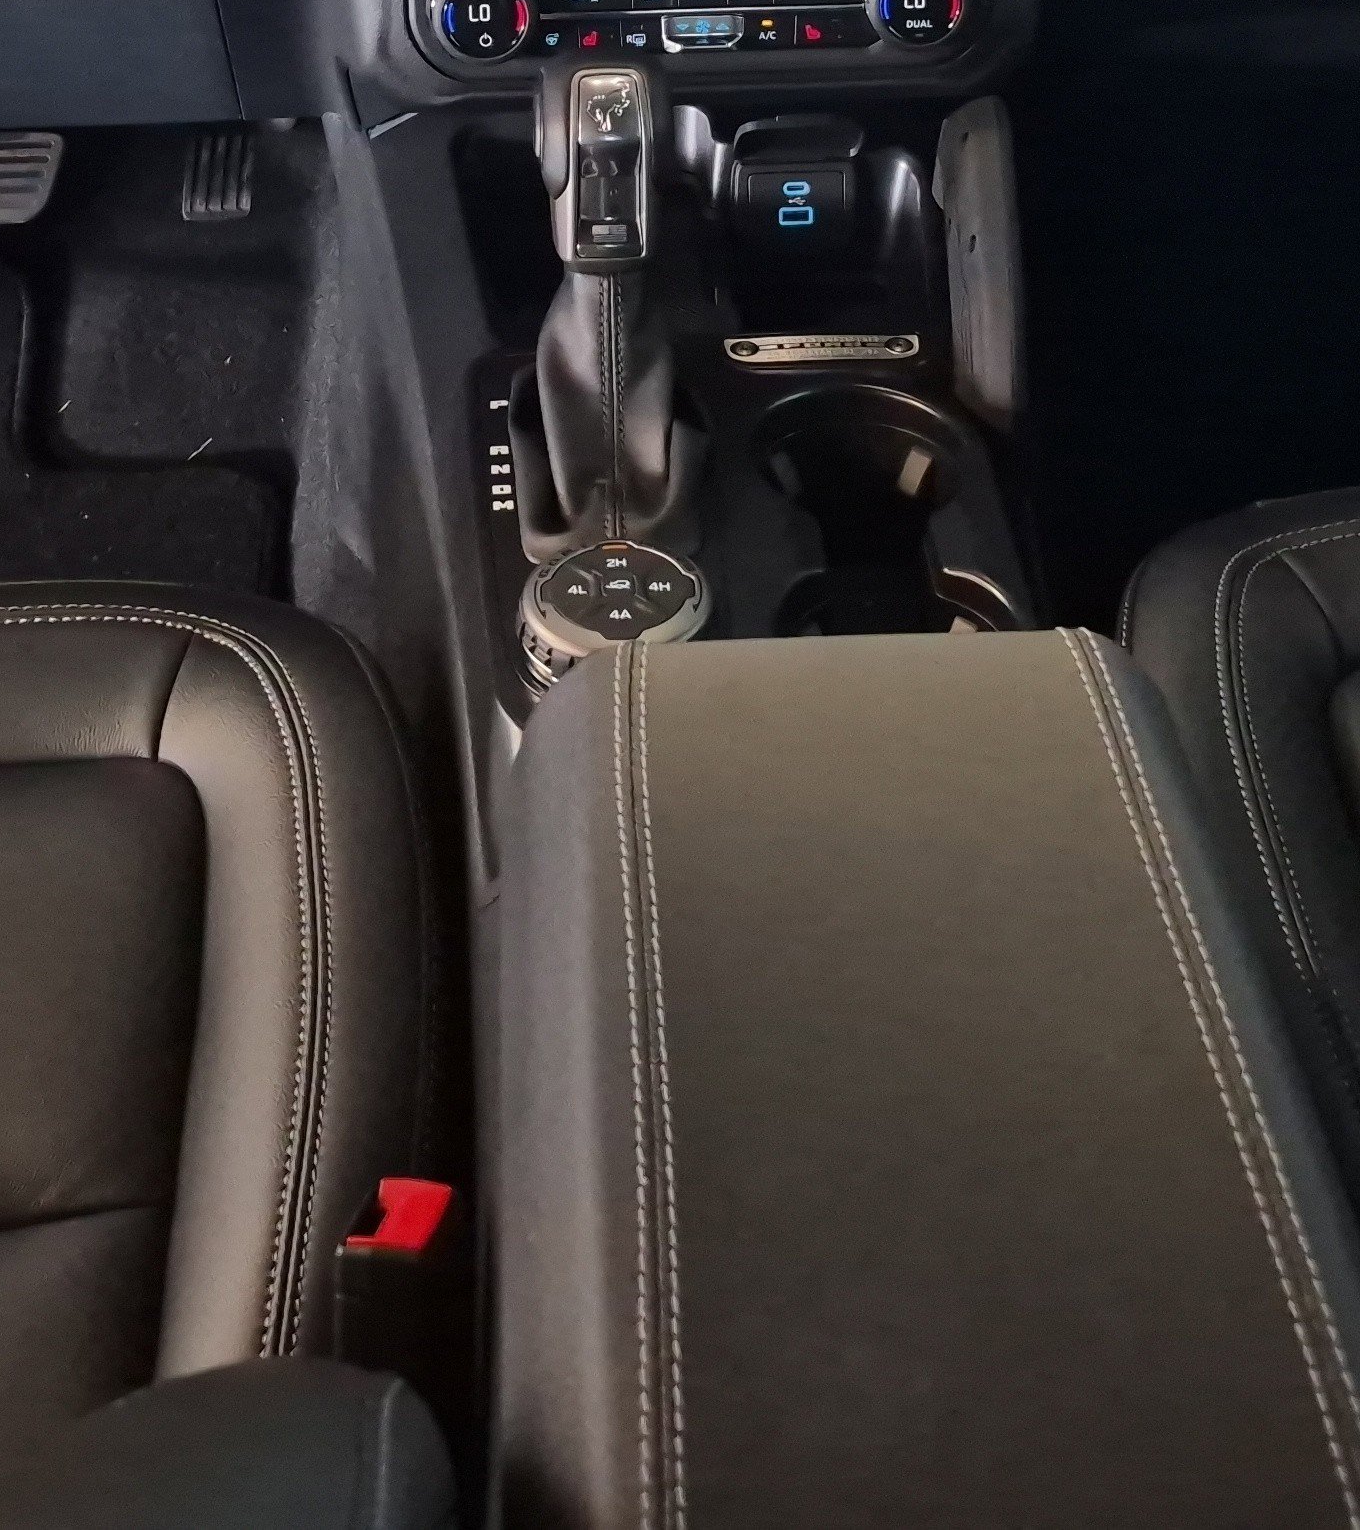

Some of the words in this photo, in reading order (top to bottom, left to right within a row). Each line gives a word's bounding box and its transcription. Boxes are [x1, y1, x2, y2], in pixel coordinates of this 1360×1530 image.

[468, 4, 490, 22] LO
[906, 19, 933, 29] DUAL
[759, 31, 777, 41] A/C
[490, 400, 508, 409] P
[491, 464, 510, 474] N
[493, 500, 514, 510] M
[606, 557, 628, 568] 2H
[567, 585, 588, 595] 4L
[649, 582, 671, 592] 4H
[609, 609, 632, 620] 4A
